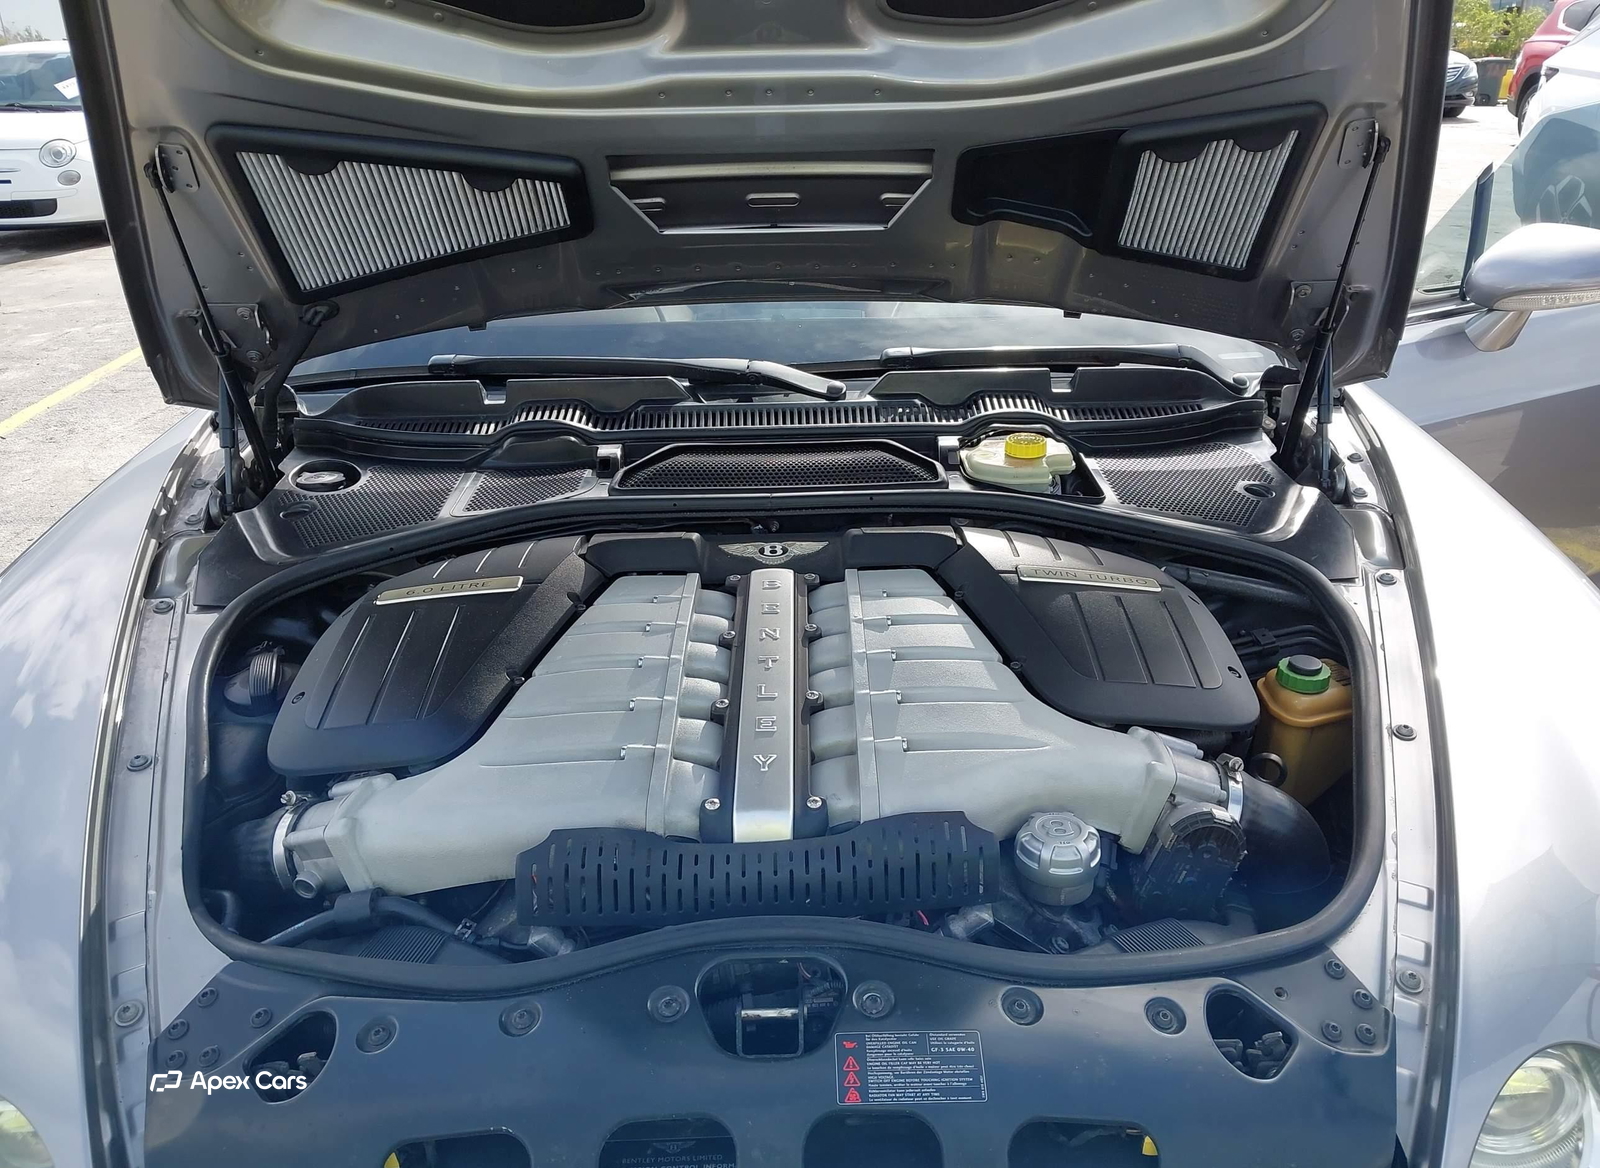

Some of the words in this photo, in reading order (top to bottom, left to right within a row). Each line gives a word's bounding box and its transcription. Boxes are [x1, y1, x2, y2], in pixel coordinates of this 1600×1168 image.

[1030, 569, 1078, 578] TWIN
[1088, 573, 1149, 585] TURBO
[406, 587, 434, 596] 6.0
[439, 580, 493, 592] LITRE
[753, 579, 782, 772] BENTLEY
[657, 1155, 690, 1163] MOTORS
